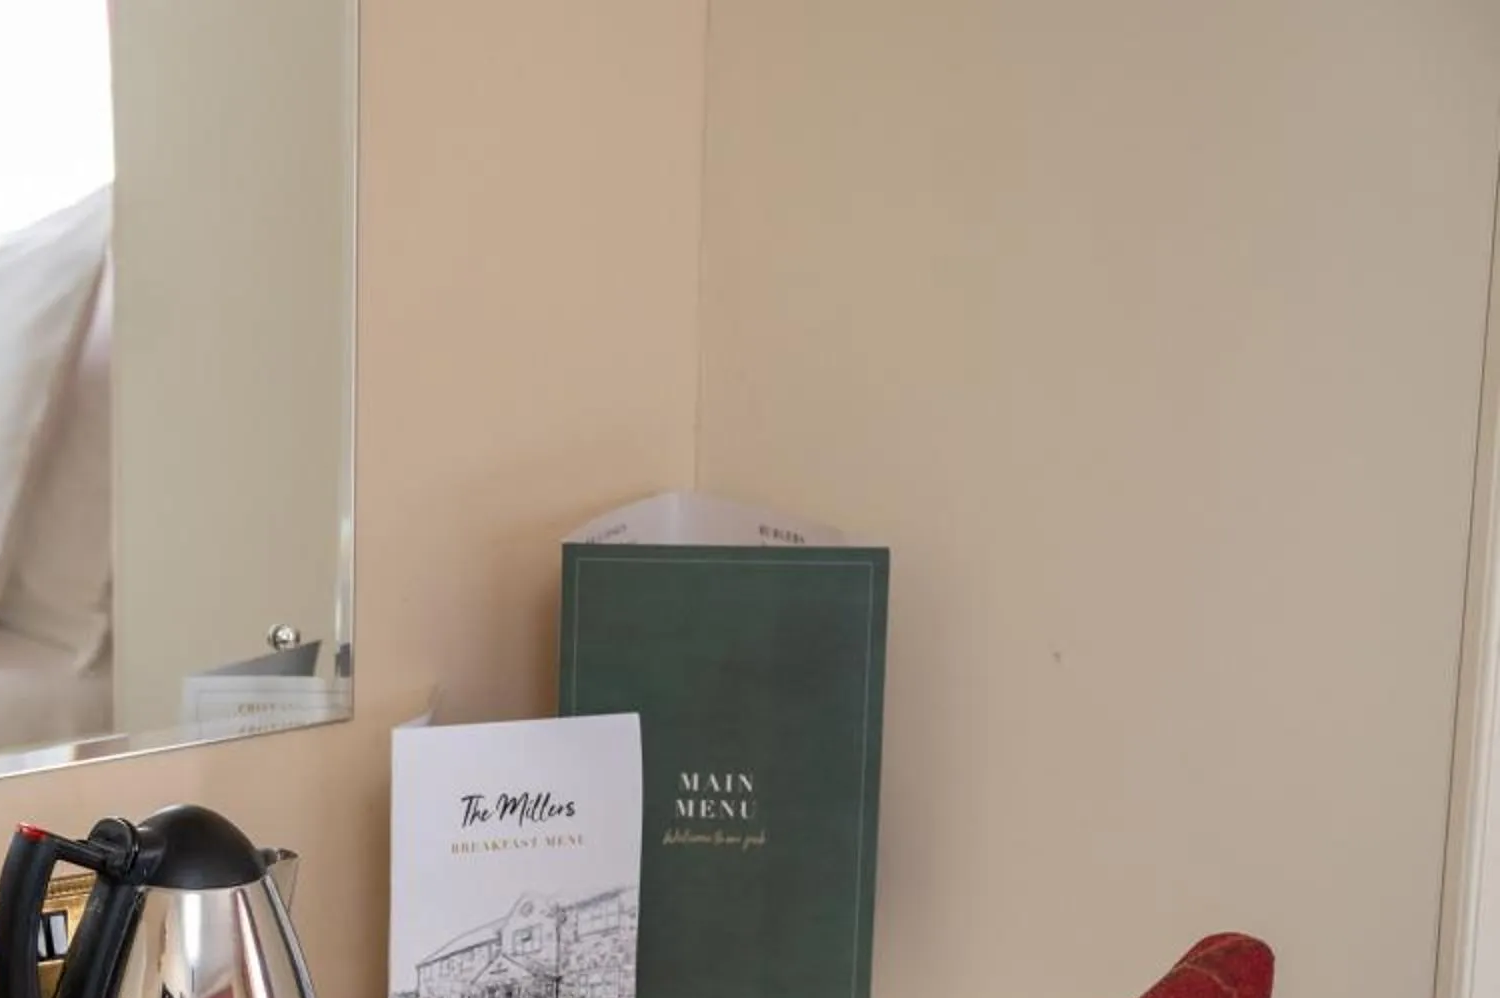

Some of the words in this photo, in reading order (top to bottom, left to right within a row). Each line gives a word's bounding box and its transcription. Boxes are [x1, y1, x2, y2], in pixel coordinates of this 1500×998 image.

[679, 771, 754, 793] MAIN
[460, 794, 492, 828] The
[495, 791, 576, 828] Millers
[676, 799, 757, 819] MENU
[451, 836, 538, 855] BREAKFAST
[544, 833, 584, 849] MENU
